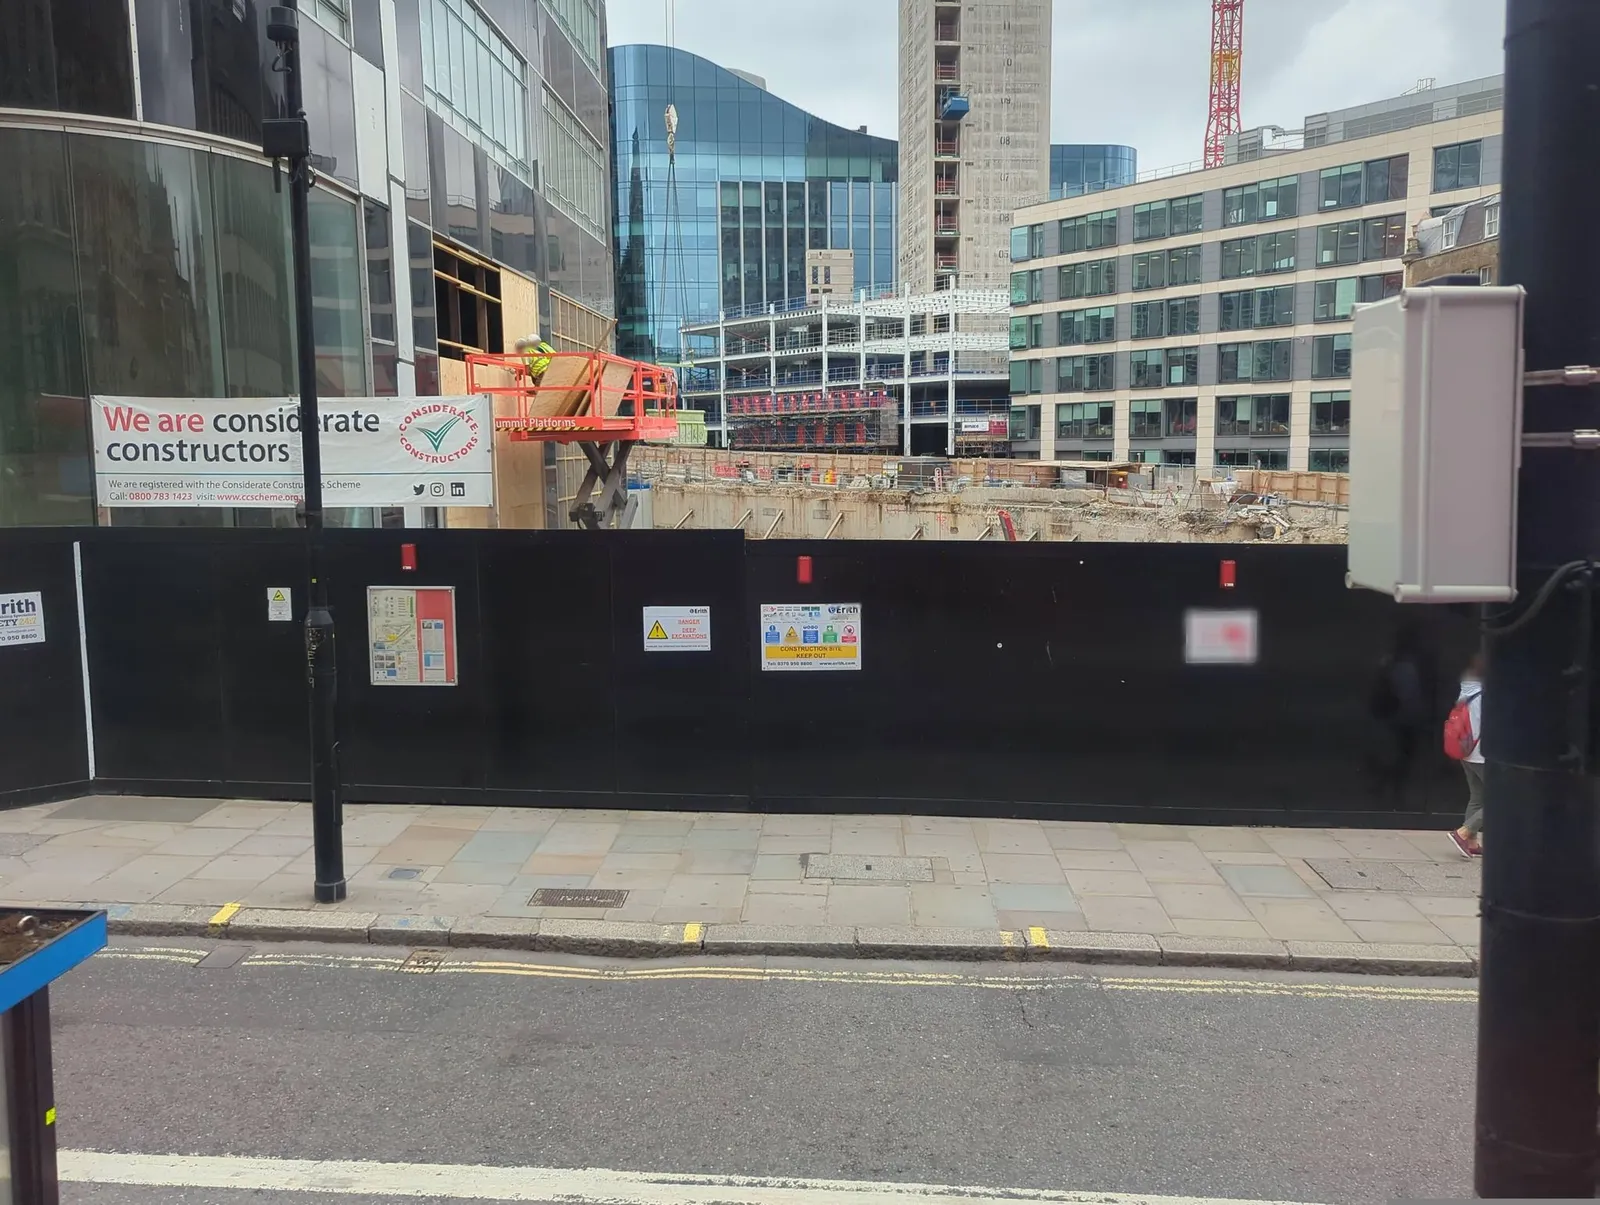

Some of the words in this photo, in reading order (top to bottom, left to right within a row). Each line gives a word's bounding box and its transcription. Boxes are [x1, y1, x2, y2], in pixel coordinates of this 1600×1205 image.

[103, 406, 150, 432] We
[158, 413, 204, 432] are
[213, 408, 380, 433] considrate
[399, 404, 479, 432] CONSIDERATE
[529, 418, 576, 428] Platforms
[107, 439, 290, 463] constructors
[400, 436, 478, 464] CONSTRUCTORS
[108, 480, 122, 488] We
[139, 481, 184, 490] registered
[186, 481, 204, 489] with
[206, 481, 220, 489] the
[222, 481, 271, 489] Considerate
[327, 480, 361, 489] Scheme
[109, 492, 128, 501] Call:
[128, 492, 152, 501] 0800
[153, 492, 170, 501] 783
[172, 492, 193, 501] 1423
[196, 492, 216, 501] visit:
[836, 606, 858, 614] Erith
